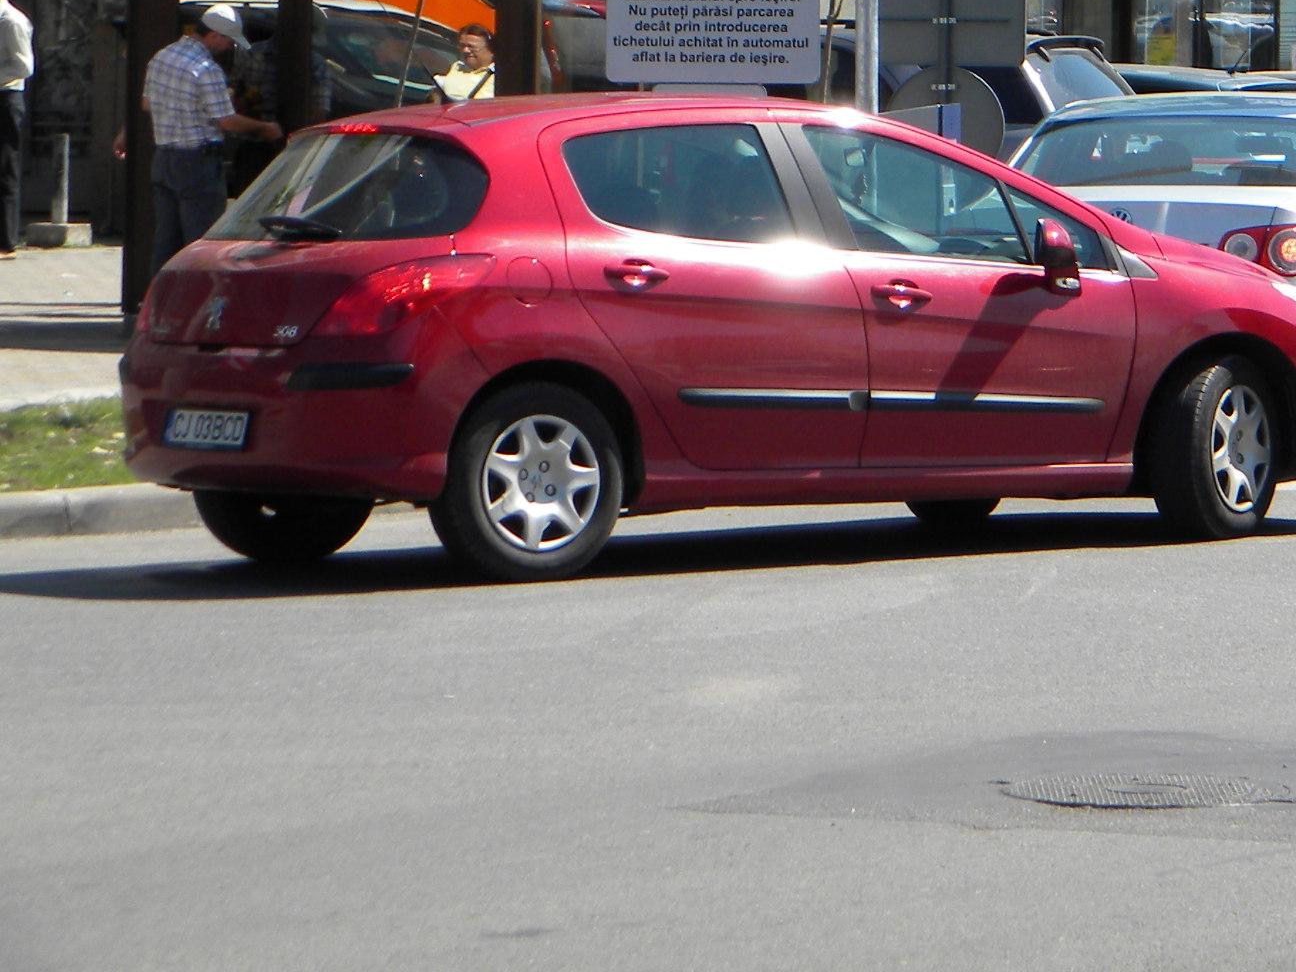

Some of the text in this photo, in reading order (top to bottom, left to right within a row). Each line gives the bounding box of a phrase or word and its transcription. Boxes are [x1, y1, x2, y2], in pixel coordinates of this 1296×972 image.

[628, 5, 647, 16] Nu
[737, 7, 794, 19] parcarea
[674, 21, 700, 33] prin
[704, 21, 788, 33] introducerea
[613, 36, 674, 47] tichetului
[678, 36, 723, 47] achitat
[743, 37, 809, 49] automatul
[632, 51, 660, 62] aflat
[664, 52, 676, 63] la
[680, 52, 725, 63] bariera
[729, 53, 746, 64] de
